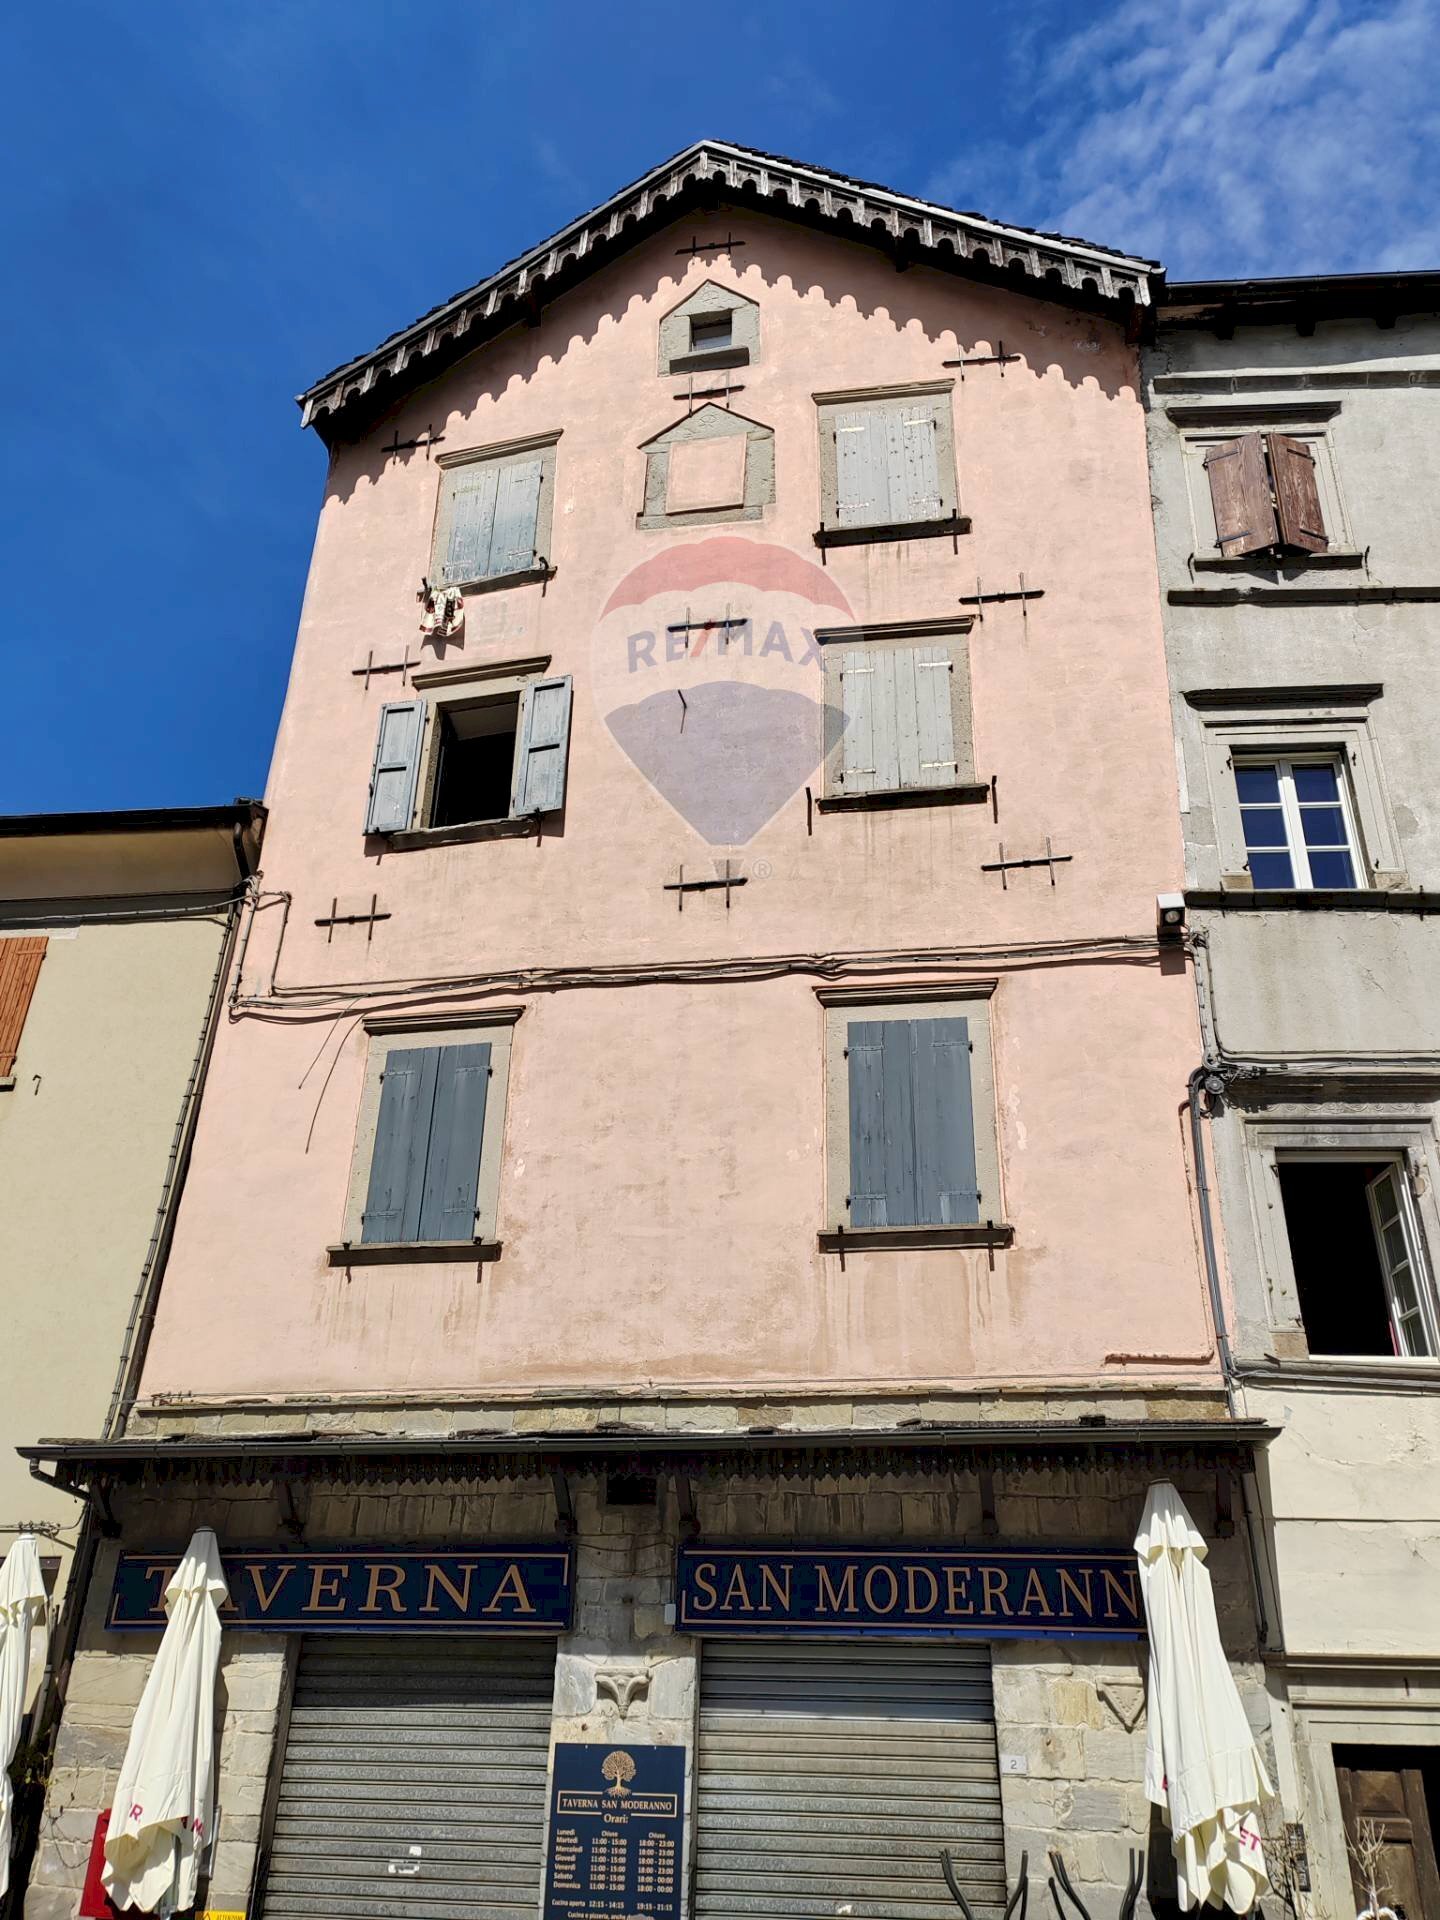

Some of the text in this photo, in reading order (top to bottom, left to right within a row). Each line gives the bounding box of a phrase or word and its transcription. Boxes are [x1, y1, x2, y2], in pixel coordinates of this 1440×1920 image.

[145, 1564, 537, 1614] TVERNA
[693, 1562, 1139, 1619] SAN MODERANN
[1010, 1759, 1017, 1770] 2
[562, 1798, 673, 1811] TAVERNA SAN MODERANNO
[603, 1814, 629, 1823] Orari:
